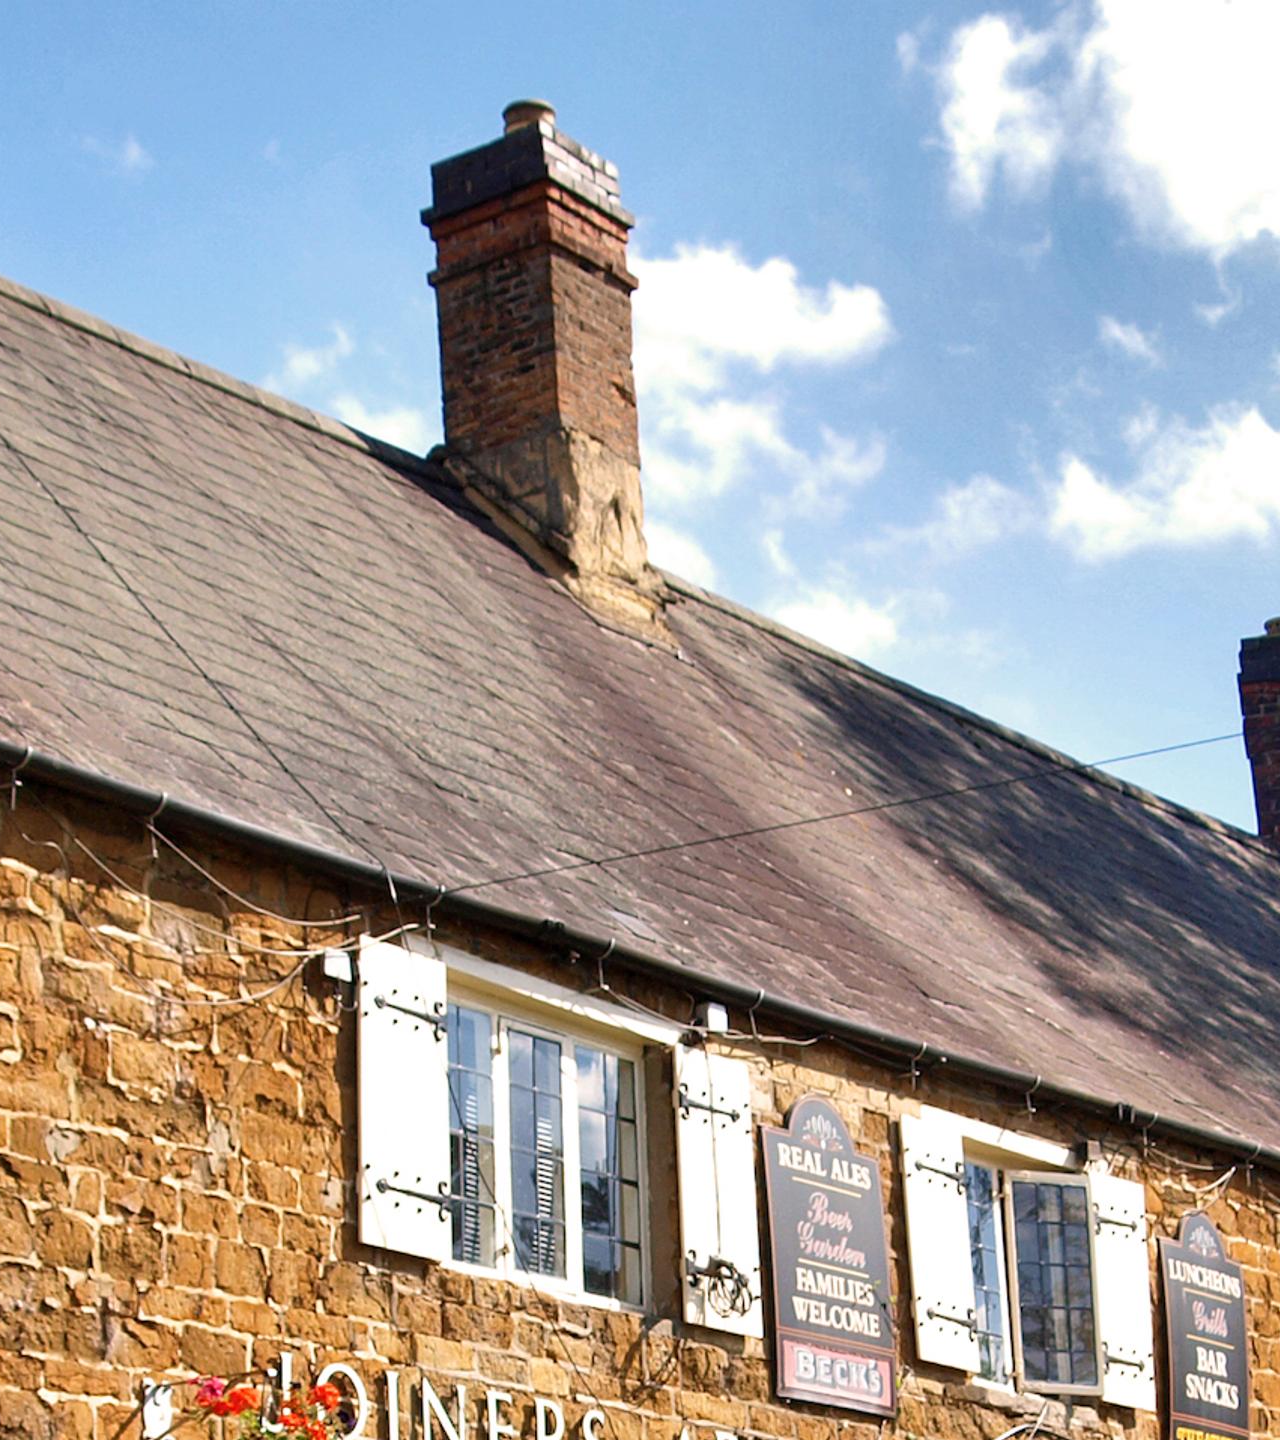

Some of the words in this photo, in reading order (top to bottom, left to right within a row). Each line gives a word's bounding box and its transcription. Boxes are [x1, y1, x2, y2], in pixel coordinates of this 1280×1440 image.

[777, 1142, 828, 1177] REAL
[830, 1157, 872, 1190] ALES
[806, 1191, 853, 1233] Beer
[796, 1220, 866, 1269] Garden
[795, 1267, 875, 1307] FAMILIES
[1168, 1258, 1241, 1299] LUNCHEONS
[791, 1295, 881, 1338] WELCOME
[1192, 1300, 1228, 1338] Grills
[1196, 1346, 1228, 1378] BAR
[1185, 1373, 1240, 1410] SNACKS
